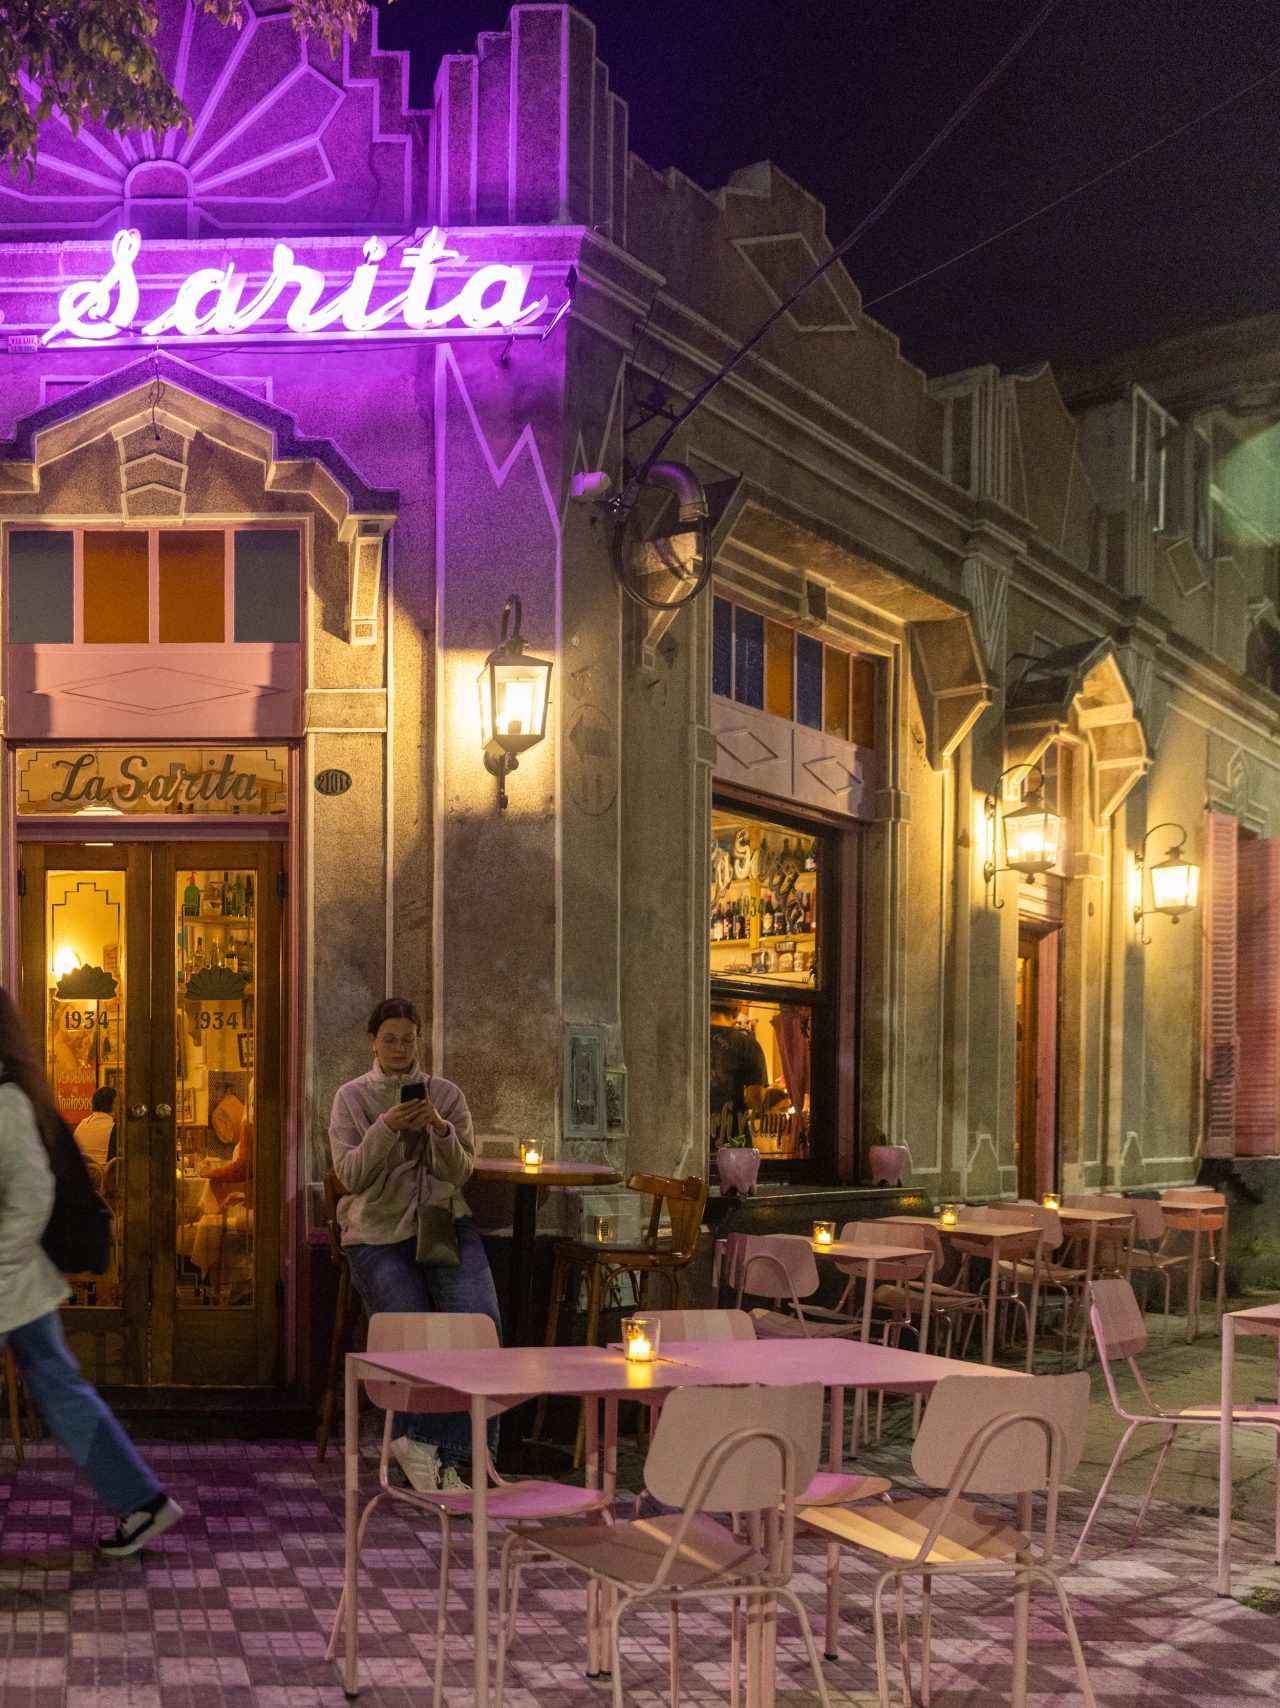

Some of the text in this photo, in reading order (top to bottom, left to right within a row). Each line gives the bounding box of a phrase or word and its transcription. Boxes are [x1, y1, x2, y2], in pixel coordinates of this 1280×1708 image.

[42, 226, 548, 343] Sarita
[51, 754, 260, 804] La Sarita
[65, 1010, 109, 1029] 1934
[194, 1011, 238, 1030] 1934
[57, 1070, 96, 1083] VENDEDORA
